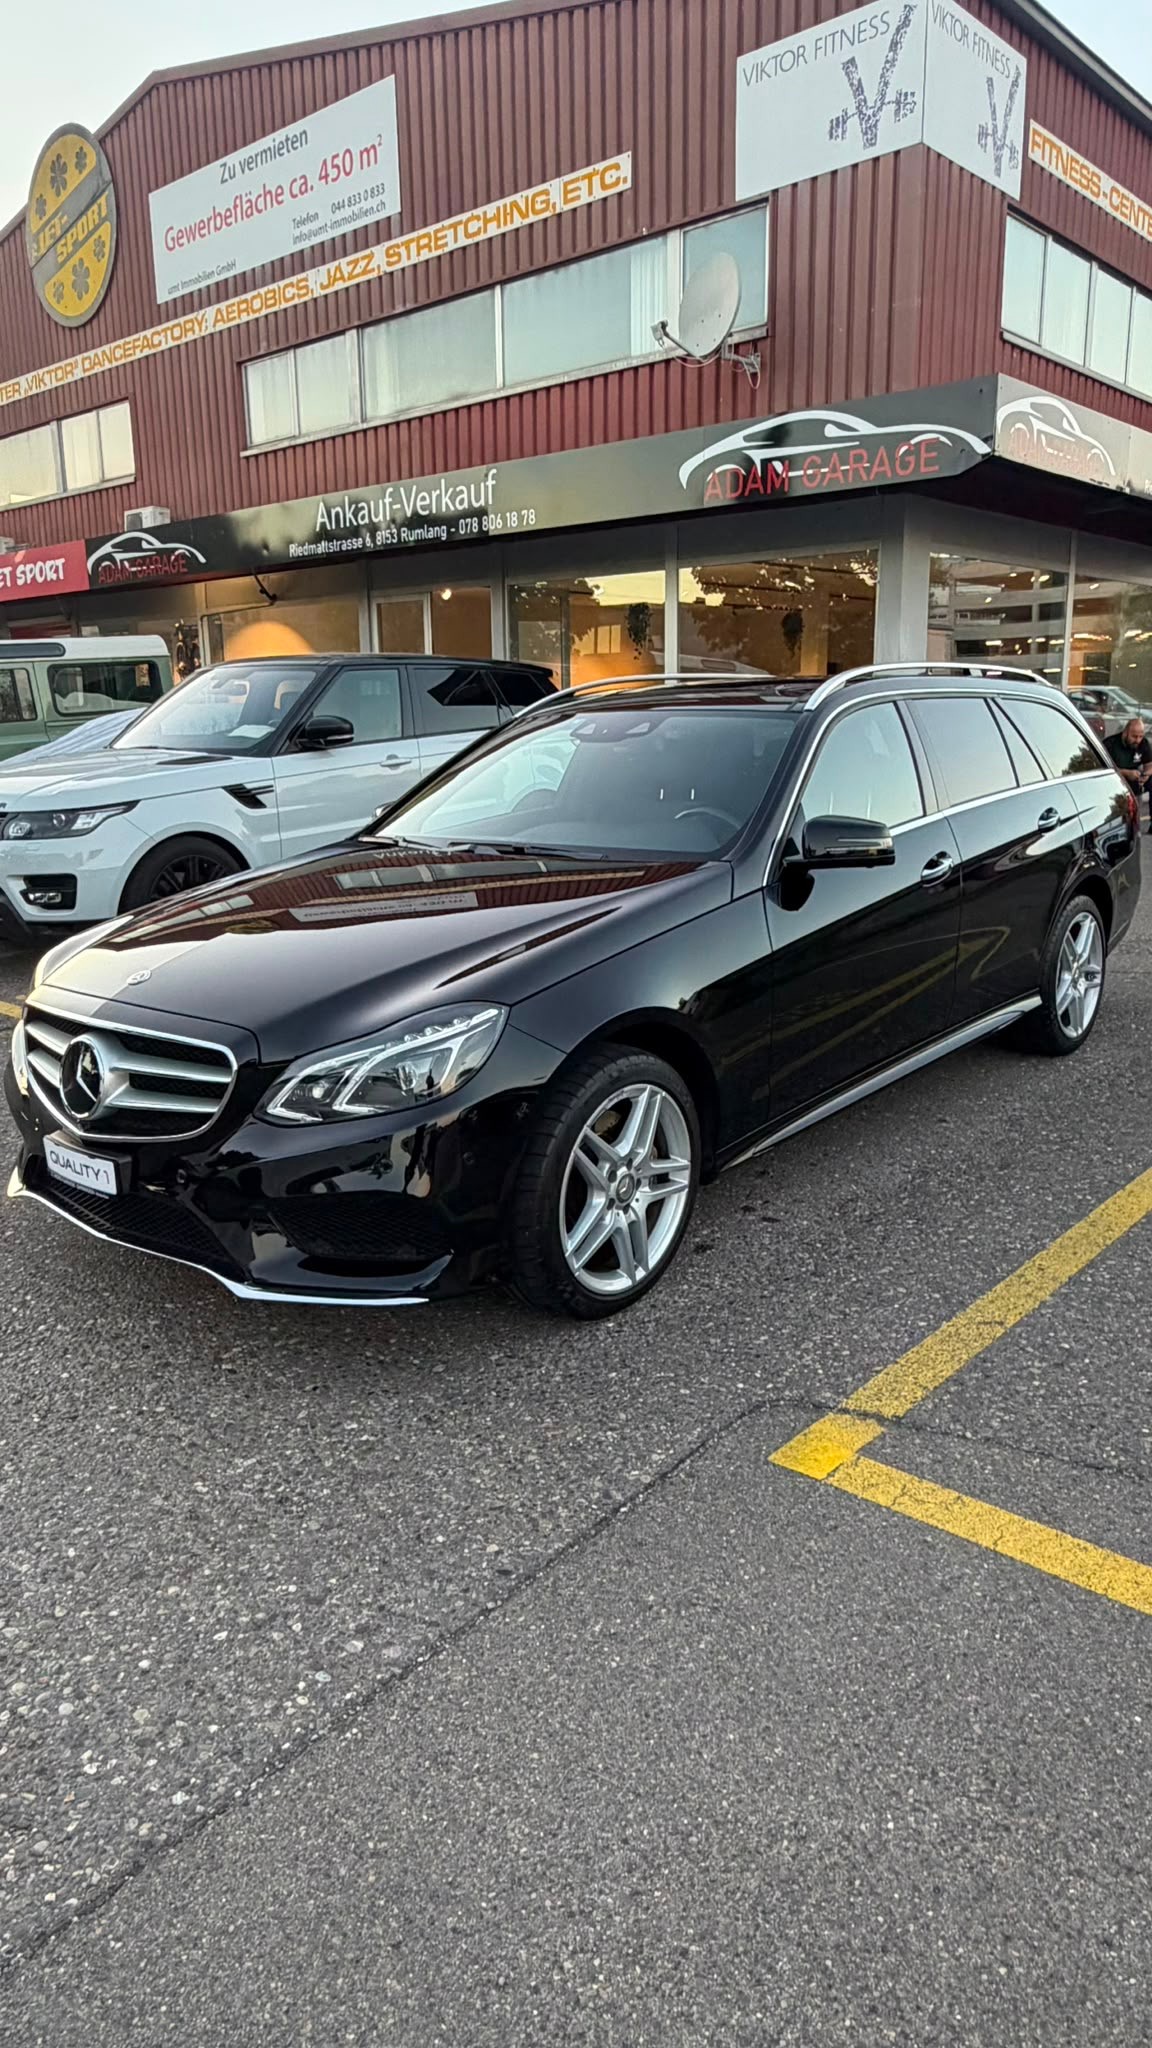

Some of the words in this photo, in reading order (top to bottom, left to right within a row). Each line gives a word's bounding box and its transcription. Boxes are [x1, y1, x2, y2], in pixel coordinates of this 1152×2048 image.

[742, 45, 808, 88] VIKTOR
[814, 9, 891, 60] FITNESS
[931, 0, 971, 50] VIKTOR
[972, 30, 1012, 80] FITNESS
[219, 161, 237, 185] Zu
[239, 128, 309, 176] vermieten
[163, 182, 285, 253] Gewerbefläche
[288, 173, 315, 200] ca.
[317, 147, 355, 186] 450
[291, 211, 320, 231] Telefon
[330, 198, 346, 215] 044
[346, 191, 363, 209] 833
[369, 181, 386, 200] 833
[212, 276, 315, 328] AEROBICS,
[318, 250, 382, 292] JAZZ,
[384, 187, 558, 269] STRETCHING,
[561, 161, 629, 205] ETC.
[215, 258, 238, 277] GmbH
[704, 459, 791, 501] ADAM
[801, 435, 941, 489] GARAGE
[288, 537, 363, 558] Riedmattstrasse
[364, 531, 374, 549] 6,
[375, 527, 398, 546] 8153
[400, 524, 448, 543] Rumlang
[458, 516, 479, 535] 078
[481, 513, 503, 531] 806
[505, 511, 518, 528] 18
[521, 508, 536, 527] 78
[16, 557, 66, 587] SPORT
[98, 565, 133, 585] ADAM
[134, 553, 189, 578] GARAGE
[49, 1150, 101, 1182] QUALITY
[102, 1169, 110, 1185] 1
